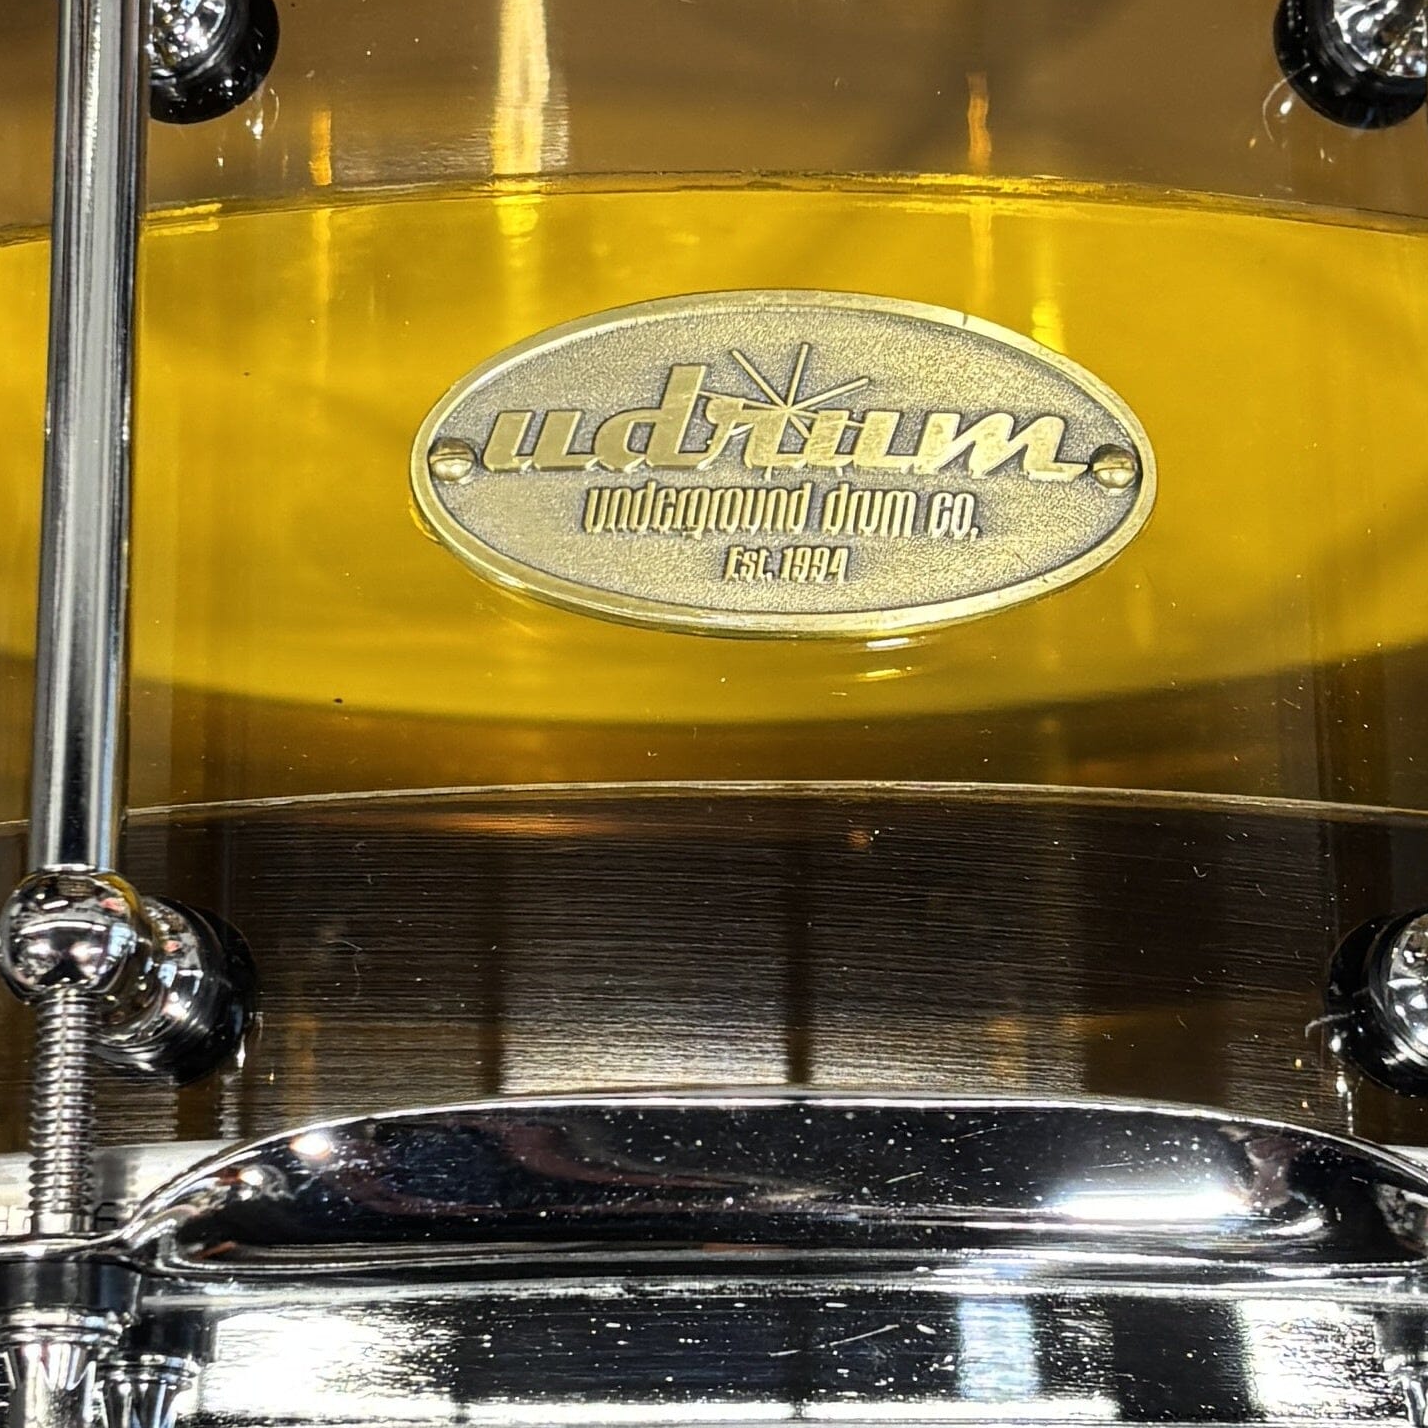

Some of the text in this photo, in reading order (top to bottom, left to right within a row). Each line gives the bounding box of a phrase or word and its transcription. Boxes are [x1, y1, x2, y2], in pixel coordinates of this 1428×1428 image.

[483, 363, 1088, 481] udrum
[584, 480, 813, 539] underground
[825, 482, 918, 538] drum
[724, 545, 849, 584] Est. 1994
